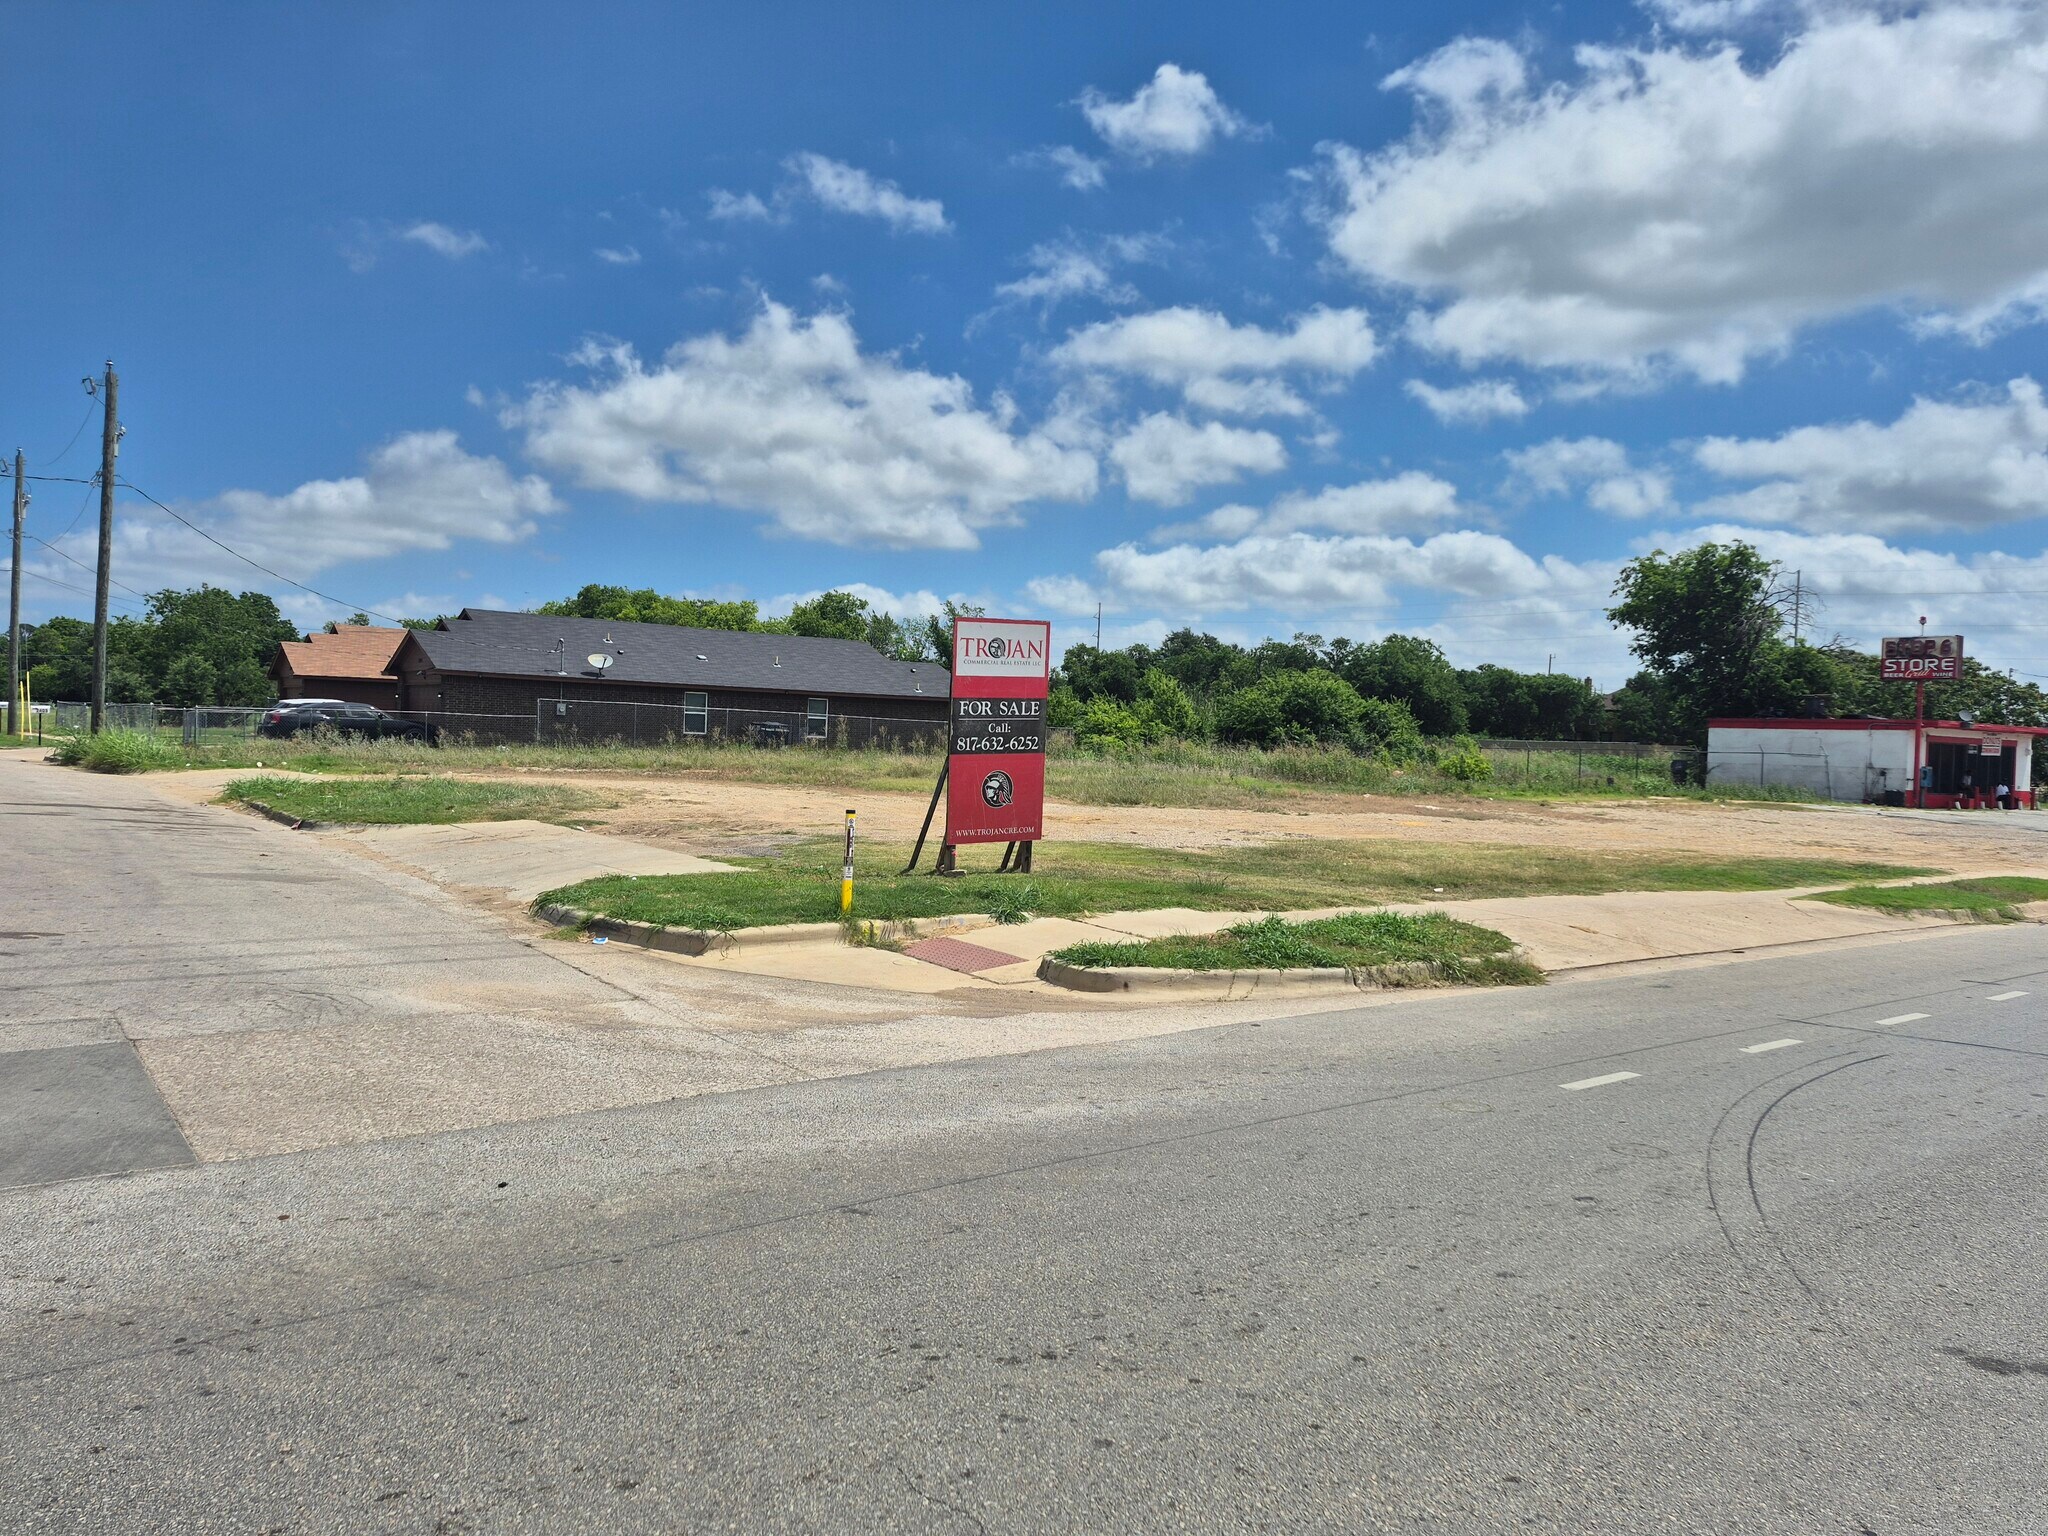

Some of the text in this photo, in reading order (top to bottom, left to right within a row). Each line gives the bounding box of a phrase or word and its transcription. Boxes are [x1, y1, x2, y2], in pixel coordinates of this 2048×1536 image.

[960, 637, 1043, 659] TROJAN
[1885, 658, 1954, 671] STORE
[959, 701, 1040, 716] FOR SALE
[988, 723, 1011, 733] Call:
[957, 736, 1039, 751] 817-632-6252
[956, 826, 1034, 837] WWW.TROJANCRE.COM
